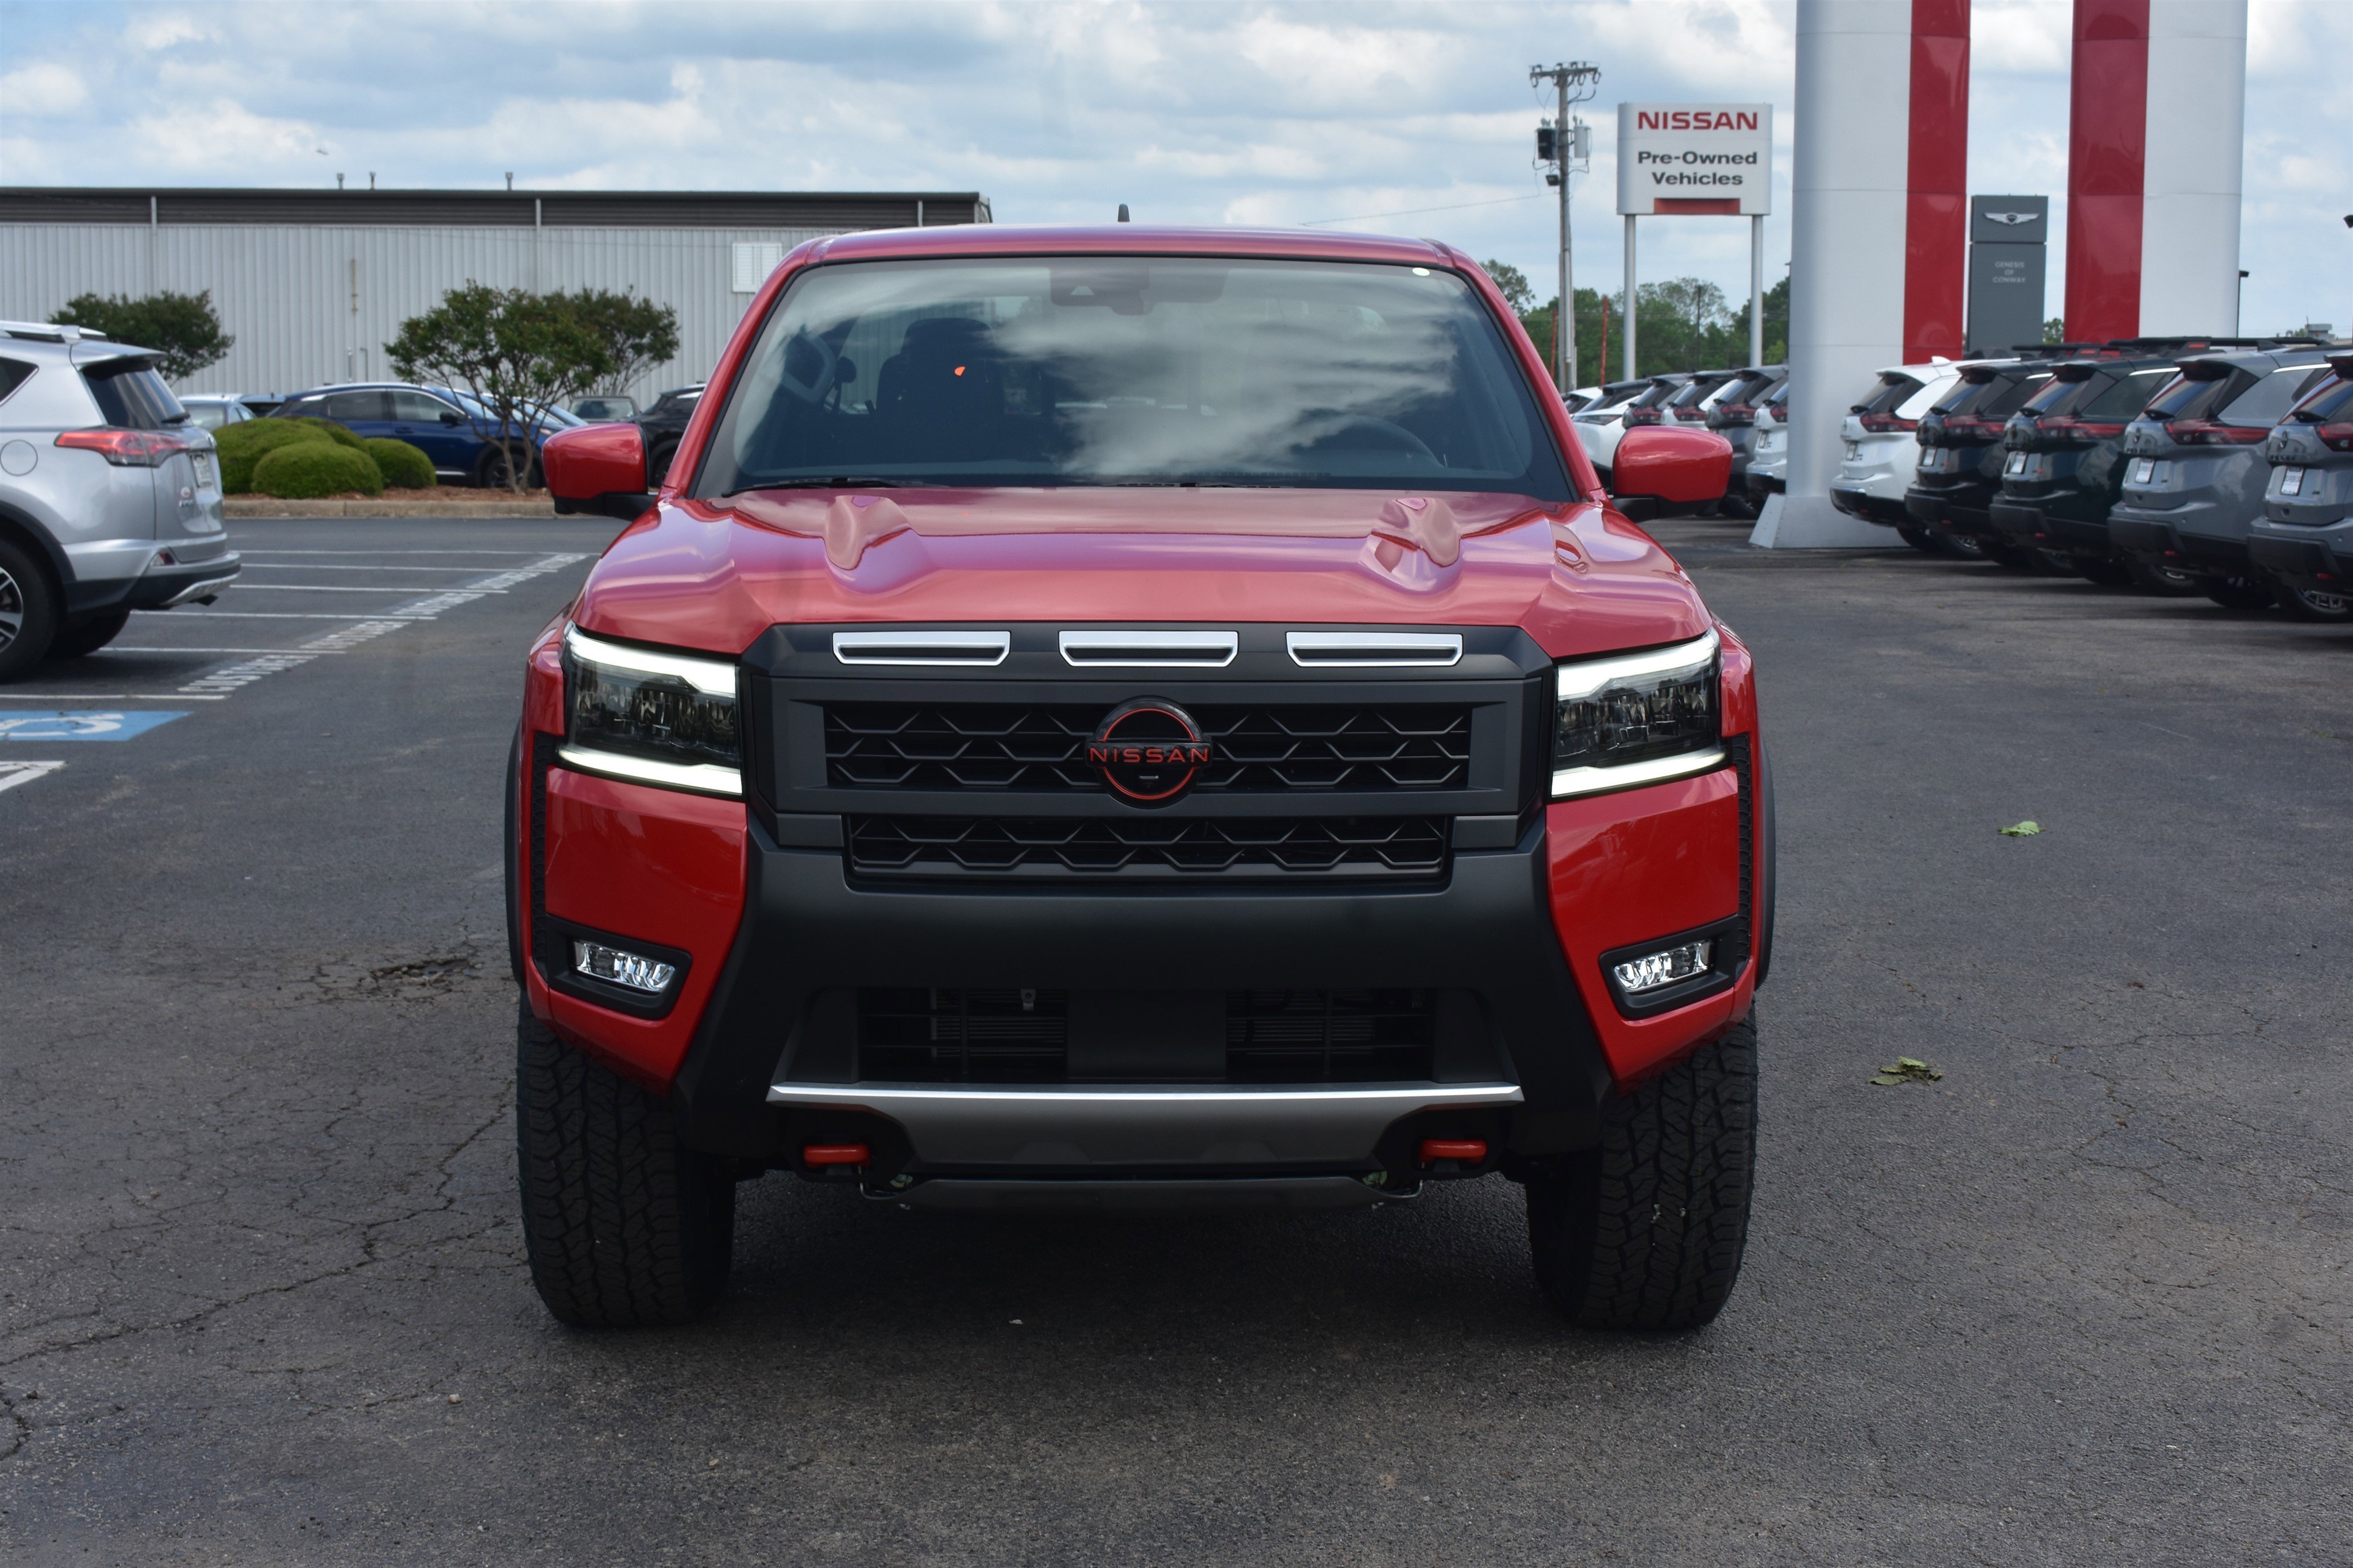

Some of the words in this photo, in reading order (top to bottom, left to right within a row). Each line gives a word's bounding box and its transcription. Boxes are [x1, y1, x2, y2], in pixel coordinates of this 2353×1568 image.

[1638, 111, 1758, 130] NISSAN
[1638, 151, 1757, 165] Pre-Owned
[1652, 172, 1743, 186] Vehicles
[1089, 748, 1209, 763] NISSAN
